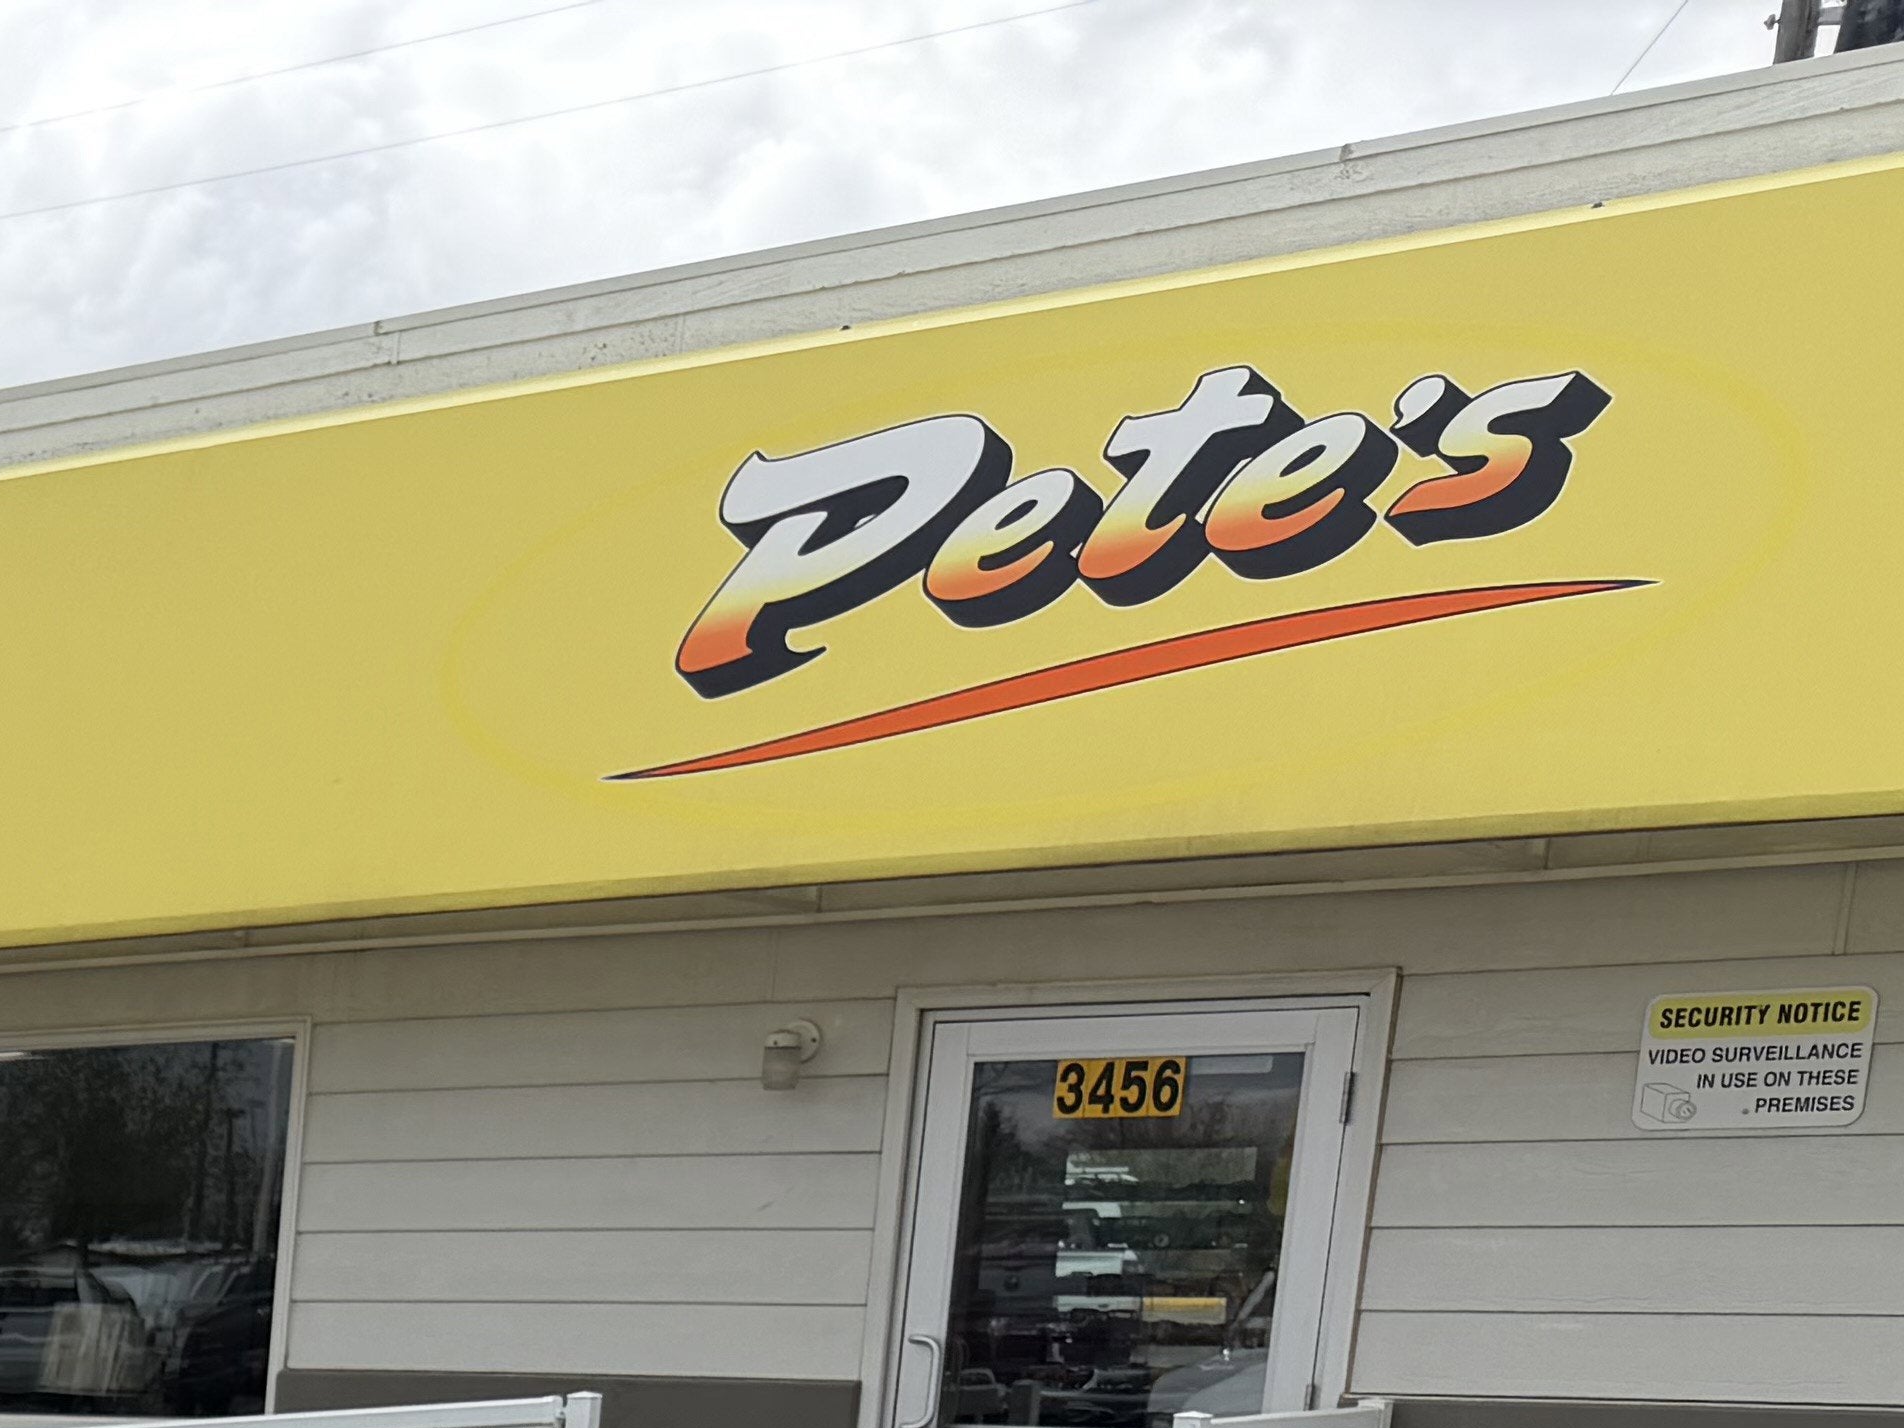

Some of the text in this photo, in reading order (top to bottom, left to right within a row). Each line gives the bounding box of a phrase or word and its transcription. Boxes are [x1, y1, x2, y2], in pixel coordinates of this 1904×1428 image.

[673, 365, 1613, 700] Pete's
[1659, 999, 1863, 1029] SECURITY NOTICE
[1648, 1042, 1864, 1065] VIDEO SURVEILLANCE
[1055, 1058, 1183, 1116] 3456
[1696, 1068, 1860, 1089] IN USE ON THESE
[1754, 1094, 1856, 1114] PREMISES
